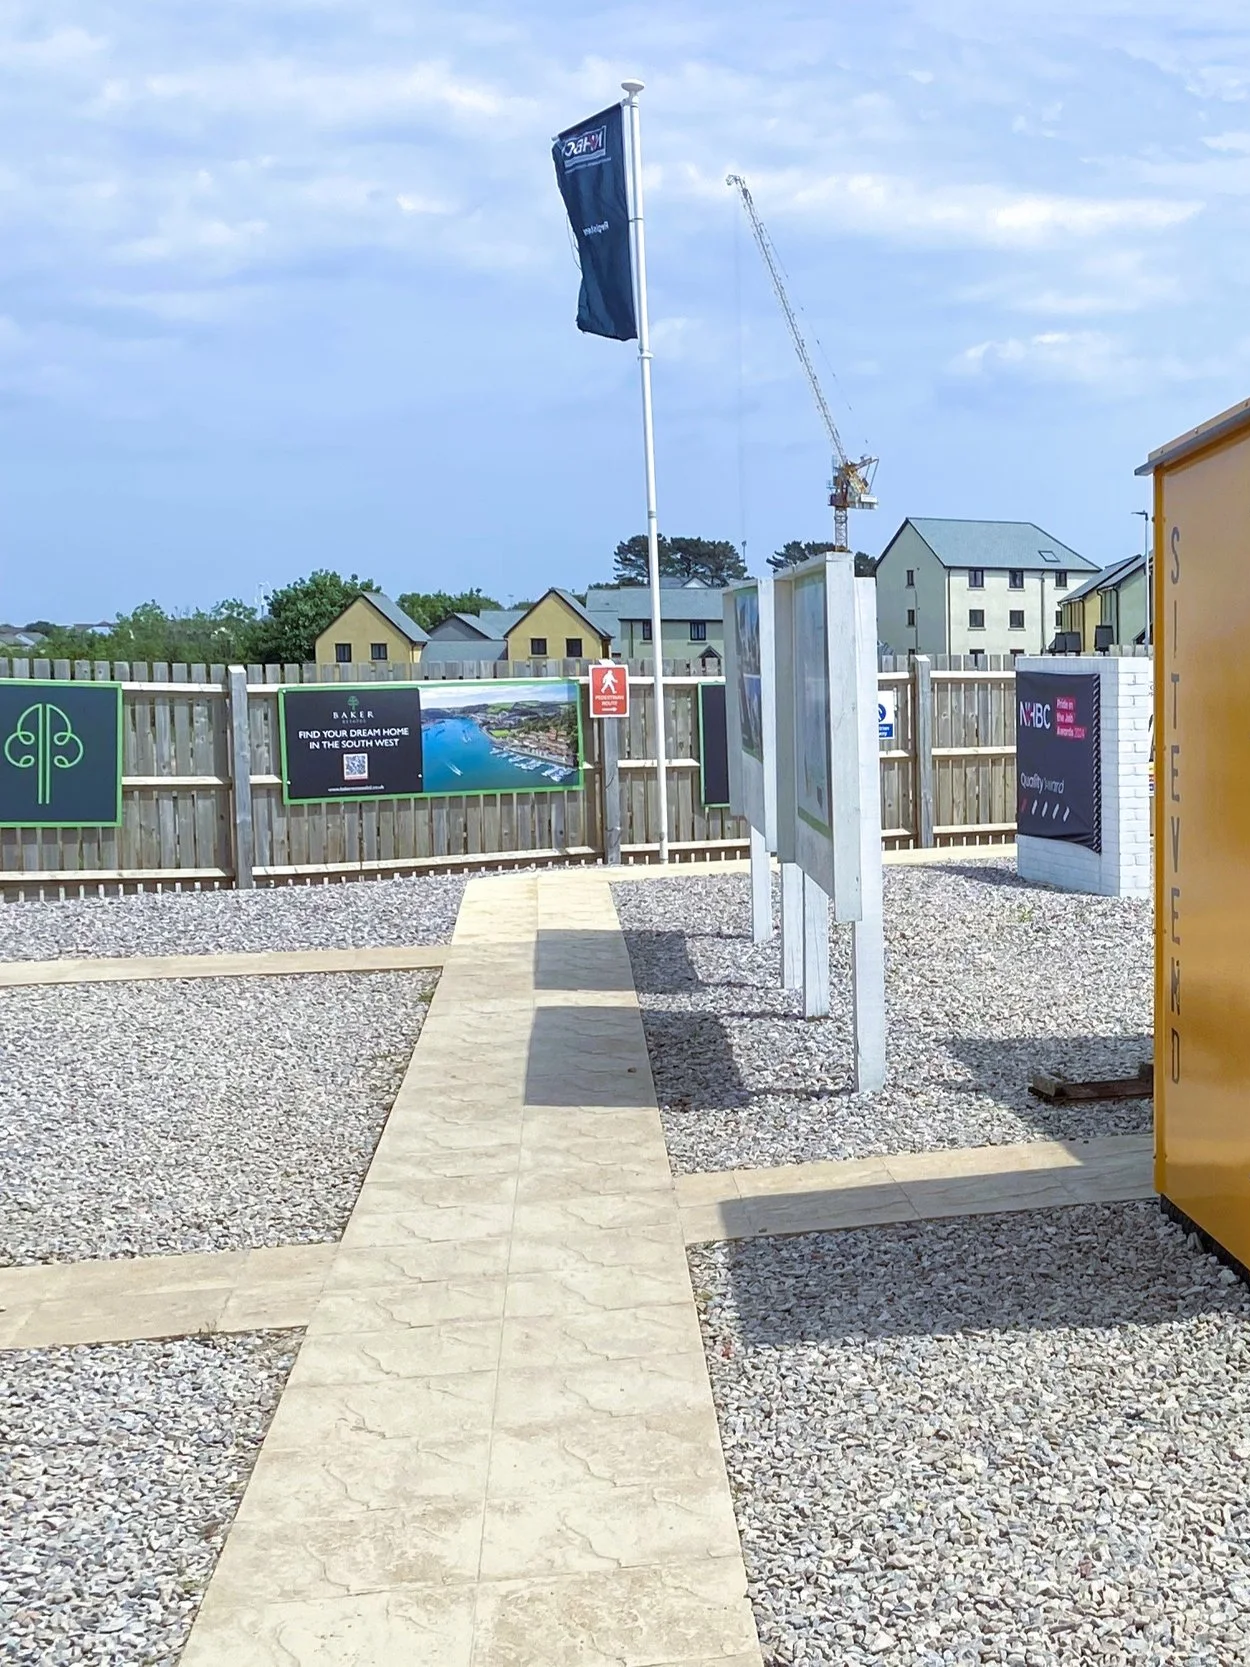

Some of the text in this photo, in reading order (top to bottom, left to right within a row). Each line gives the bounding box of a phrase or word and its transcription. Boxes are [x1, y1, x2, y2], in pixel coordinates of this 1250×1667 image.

[333, 711, 374, 719] BAKER
[1020, 701, 1050, 729] NHBC
[298, 727, 409, 739] FIND YOUR DREAM HOME
[309, 738, 400, 750] IN THE SOUTH WEST
[1020, 772, 1043, 794] Quality
[1169, 526, 1182, 1085] SITEVEND
